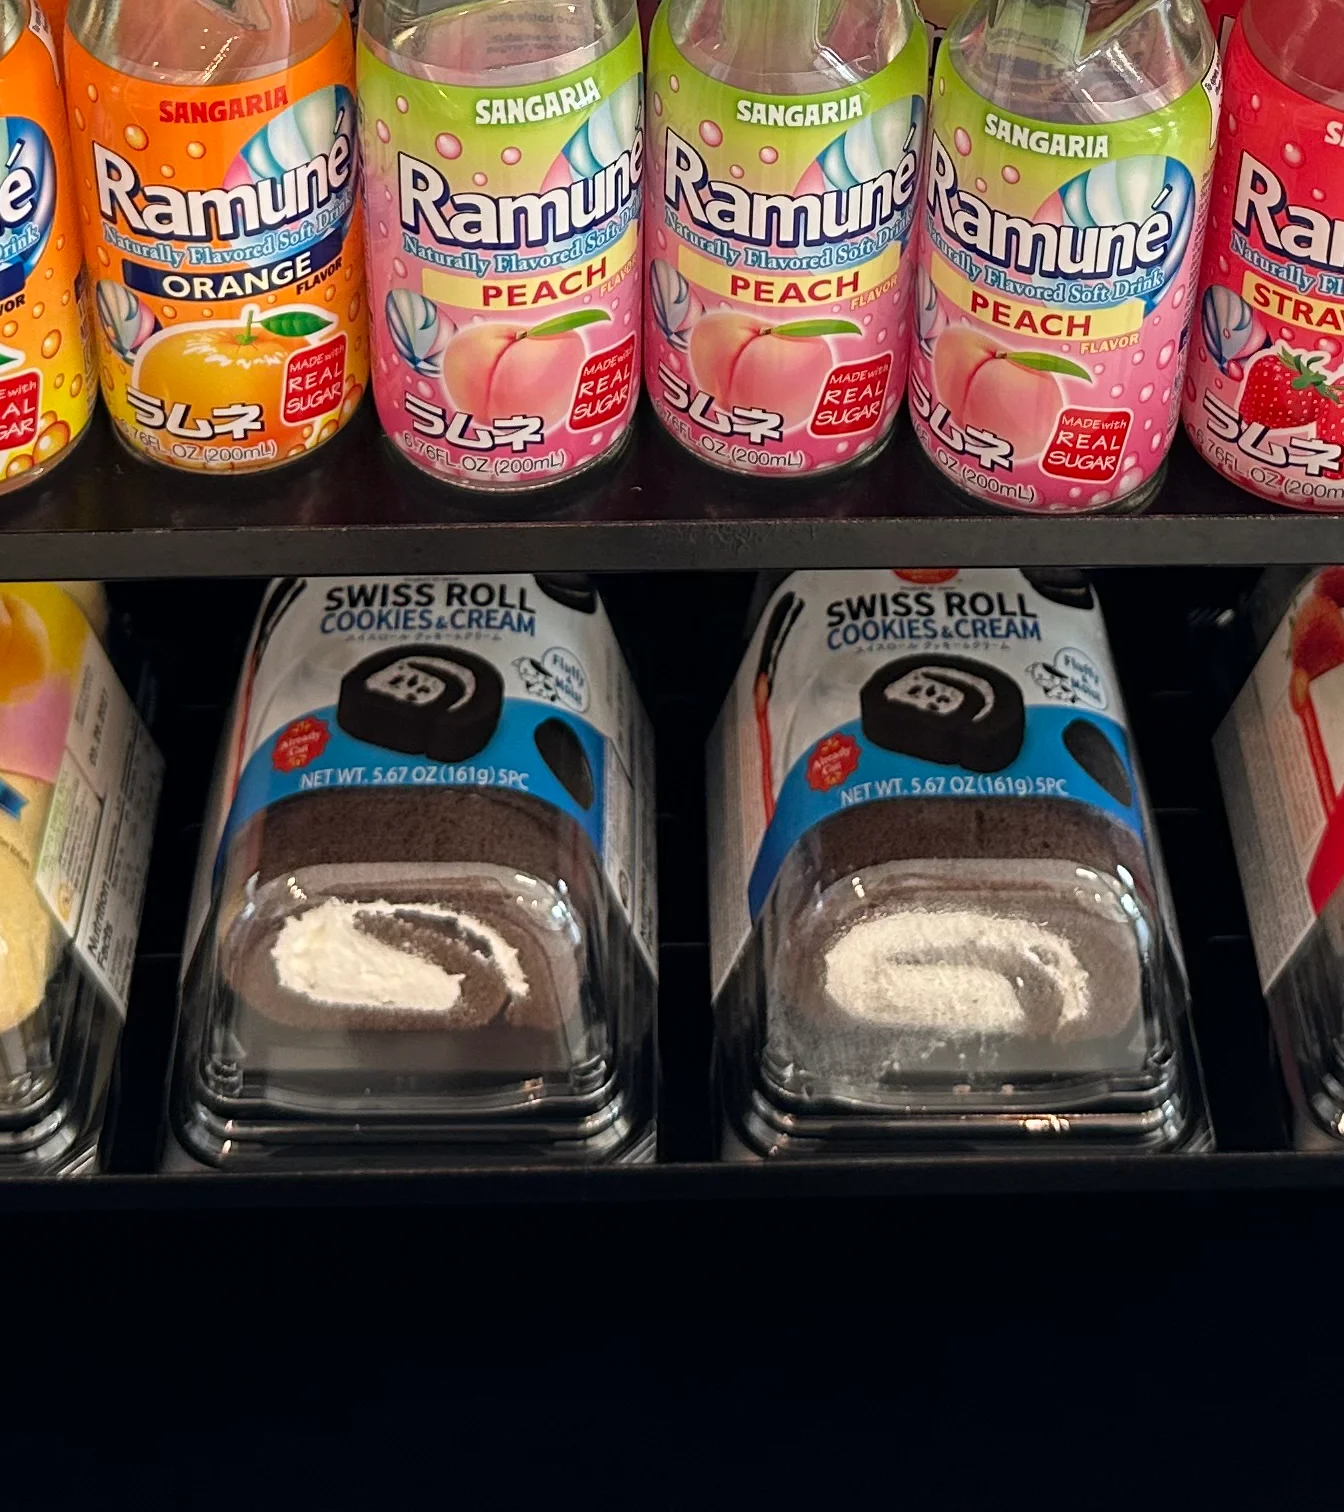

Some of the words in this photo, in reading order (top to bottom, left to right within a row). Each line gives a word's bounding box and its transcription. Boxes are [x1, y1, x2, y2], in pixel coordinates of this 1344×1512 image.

[159, 85, 290, 125] SANGARIA
[475, 76, 603, 126] SANGARIA
[736, 94, 865, 128] SANGARIA
[984, 112, 1111, 160] SANGARIA
[92, 107, 353, 243] Ramuné
[397, 105, 645, 251] Ramuné
[665, 121, 919, 249] Ramuné
[925, 129, 1173, 281] Ramuné
[102, 220, 184, 269] Naturally
[188, 236, 275, 267] Flavored
[277, 222, 315, 252] Soft
[163, 251, 313, 302] ORANGE
[481, 255, 608, 308] PEACH
[730, 271, 861, 305] PEACH
[970, 289, 1093, 338] PEACH
[126, 386, 265, 442] ラムネ
[405, 391, 547, 455] ラムネ
[323, 583, 436, 613] SWISS
[445, 582, 537, 614] ROLL
[826, 592, 935, 628] SWISS
[946, 591, 1038, 619] ROLL
[300, 769, 336, 788] NET
[336, 769, 369, 784] WT.
[372, 767, 405, 783] 5.67
[498, 769, 530, 788] 5PC
